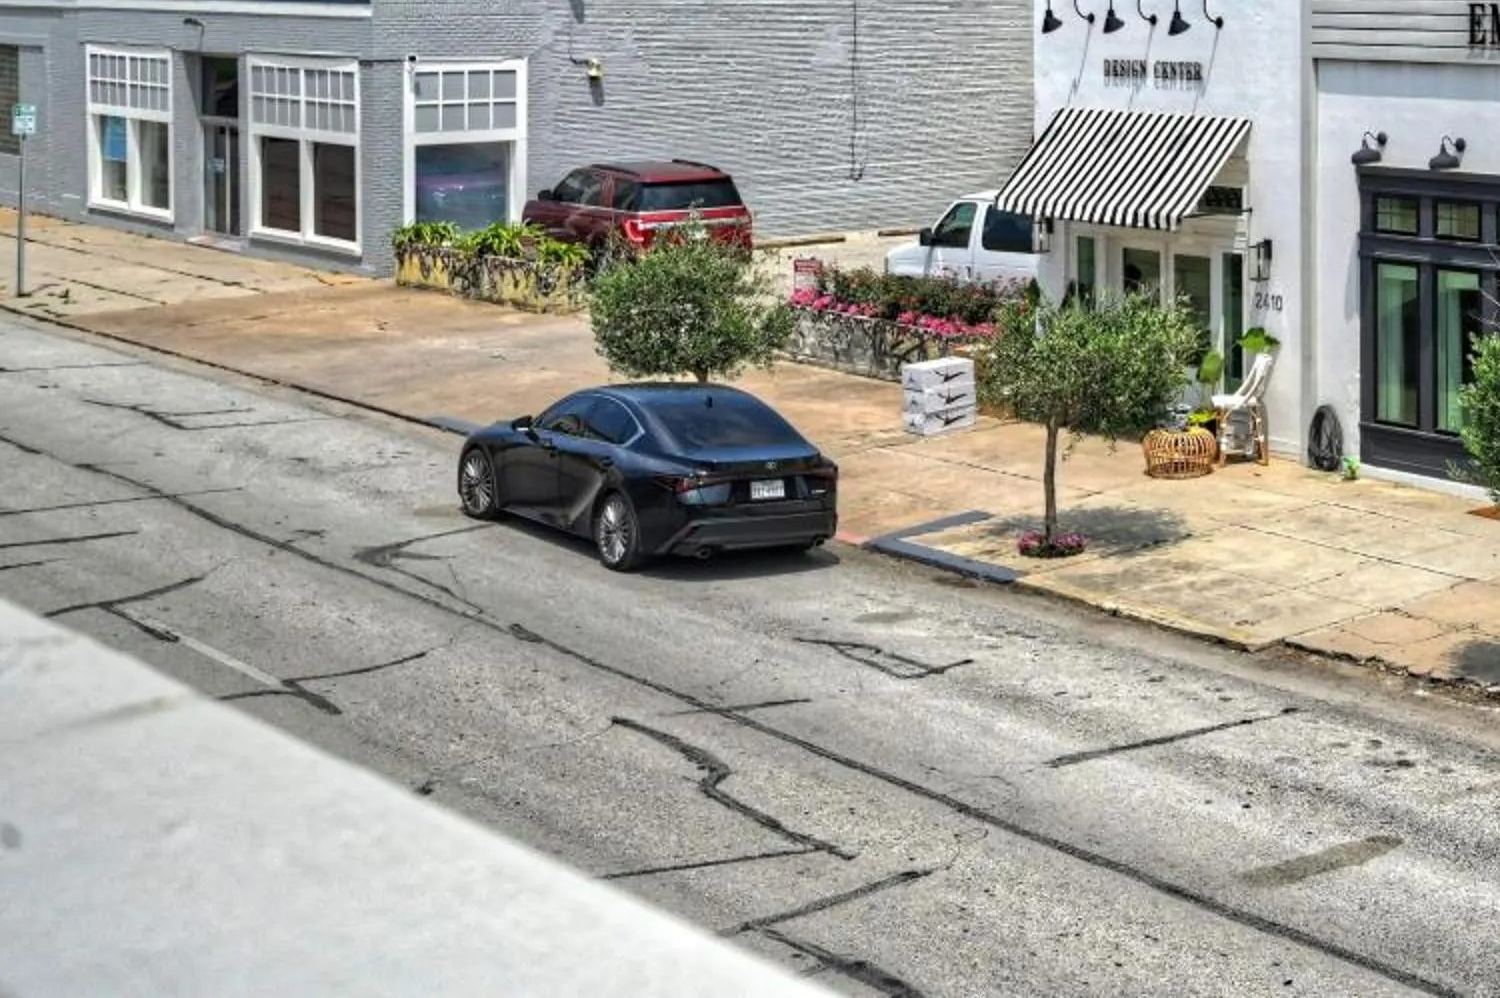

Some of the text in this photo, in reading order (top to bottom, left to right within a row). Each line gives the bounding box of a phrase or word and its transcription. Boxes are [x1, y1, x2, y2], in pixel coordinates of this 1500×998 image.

[1103, 59, 1202, 80] DESIGN CENTER
[1255, 292, 1283, 311] 2410
